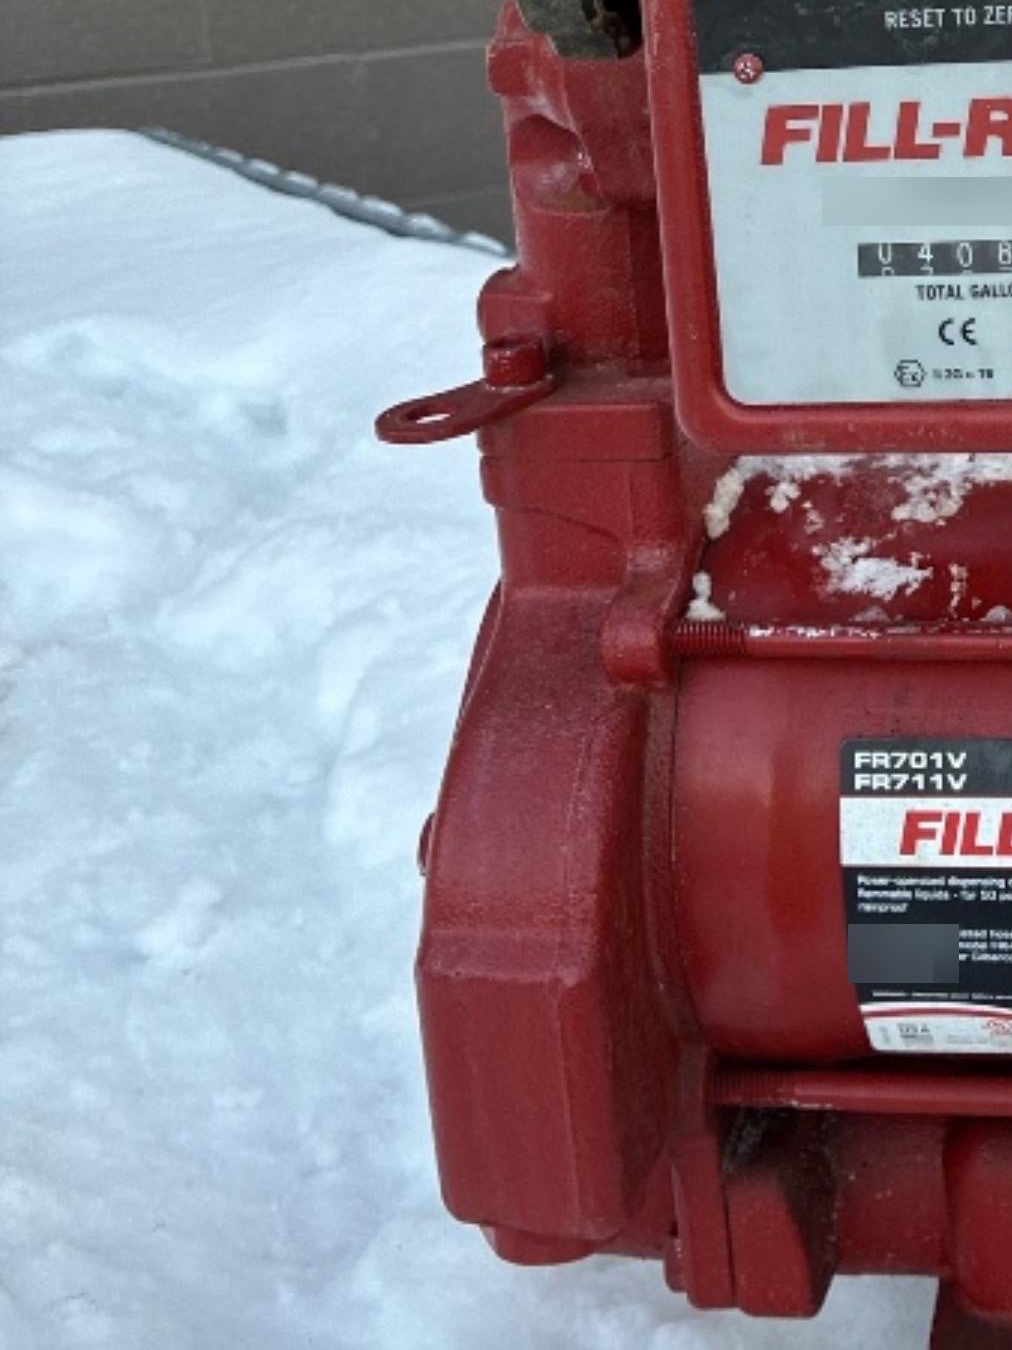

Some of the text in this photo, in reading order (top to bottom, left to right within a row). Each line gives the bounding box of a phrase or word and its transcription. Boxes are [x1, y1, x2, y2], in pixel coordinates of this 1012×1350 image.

[884, 10, 946, 29] RESET
[951, 9, 977, 27] TO
[915, 284, 963, 301] TOTAL
[938, 317, 978, 346] CE
[854, 752, 967, 769] FR701V
[854, 773, 967, 790] FR711V
